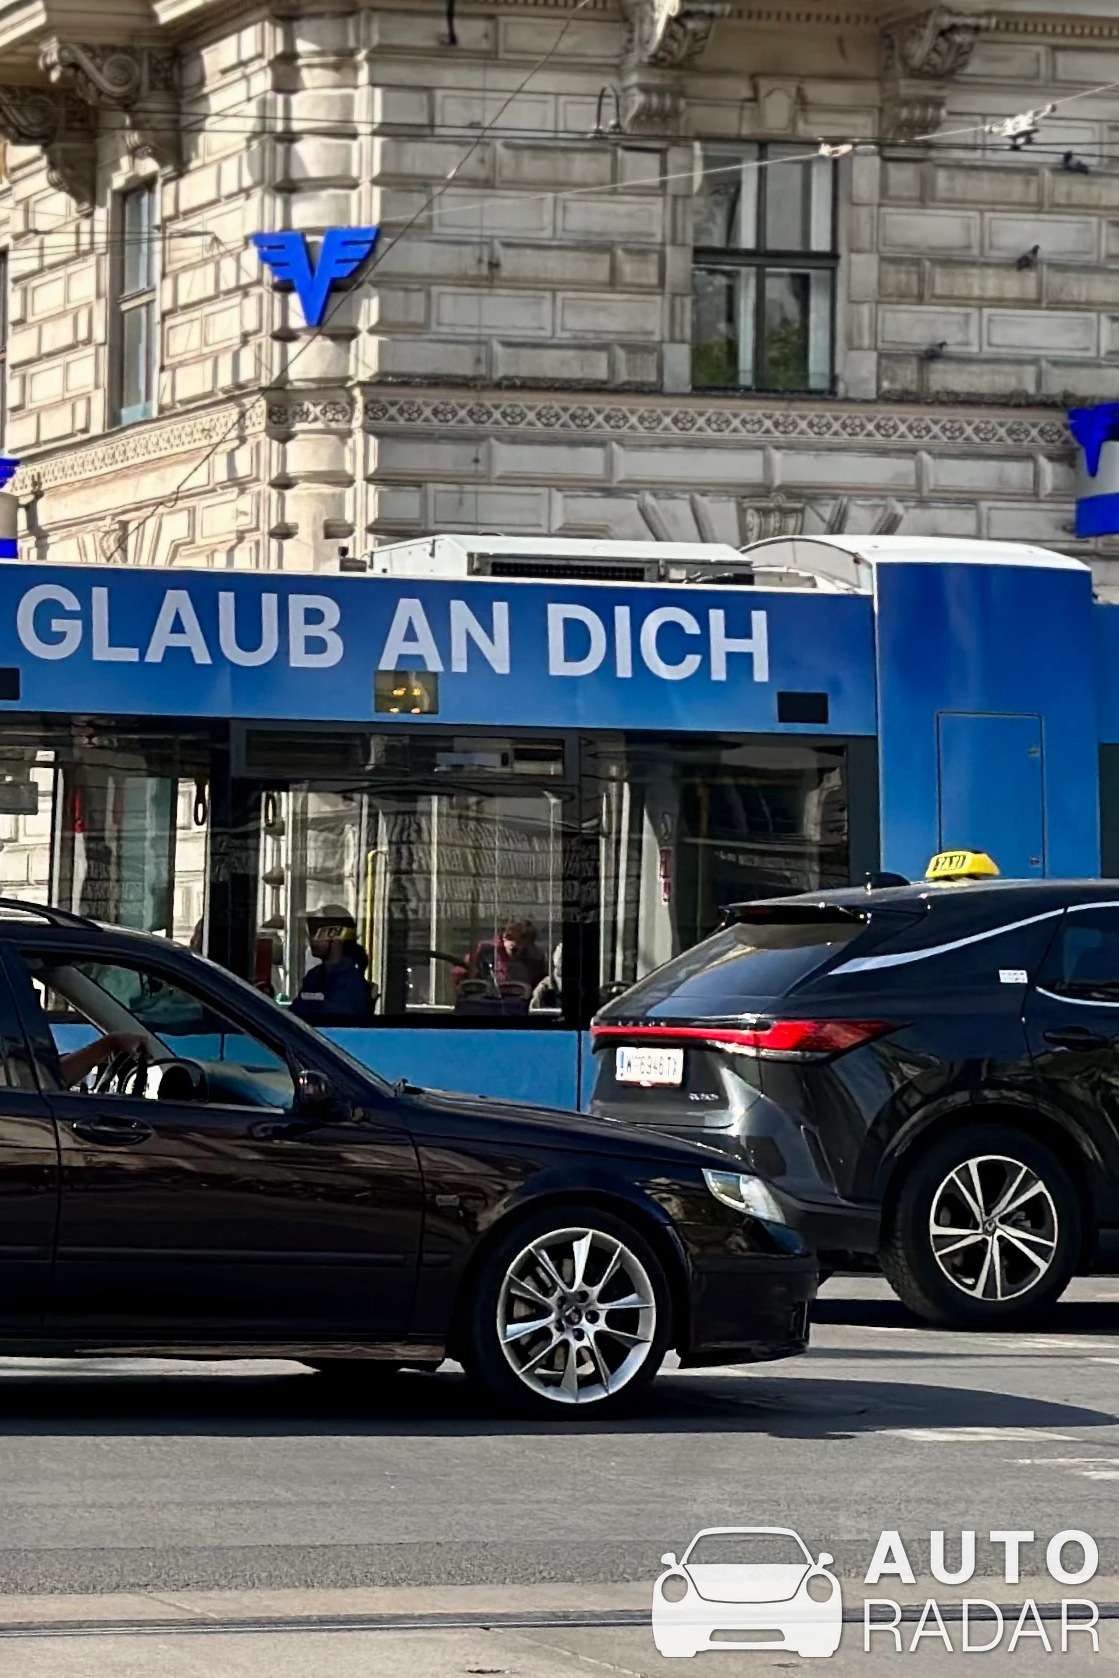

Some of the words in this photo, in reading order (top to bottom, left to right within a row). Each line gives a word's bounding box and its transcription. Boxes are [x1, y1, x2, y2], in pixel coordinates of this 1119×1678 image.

[16, 584, 344, 668] GLAUB
[378, 598, 510, 675] AN
[547, 603, 769, 682] DICH
